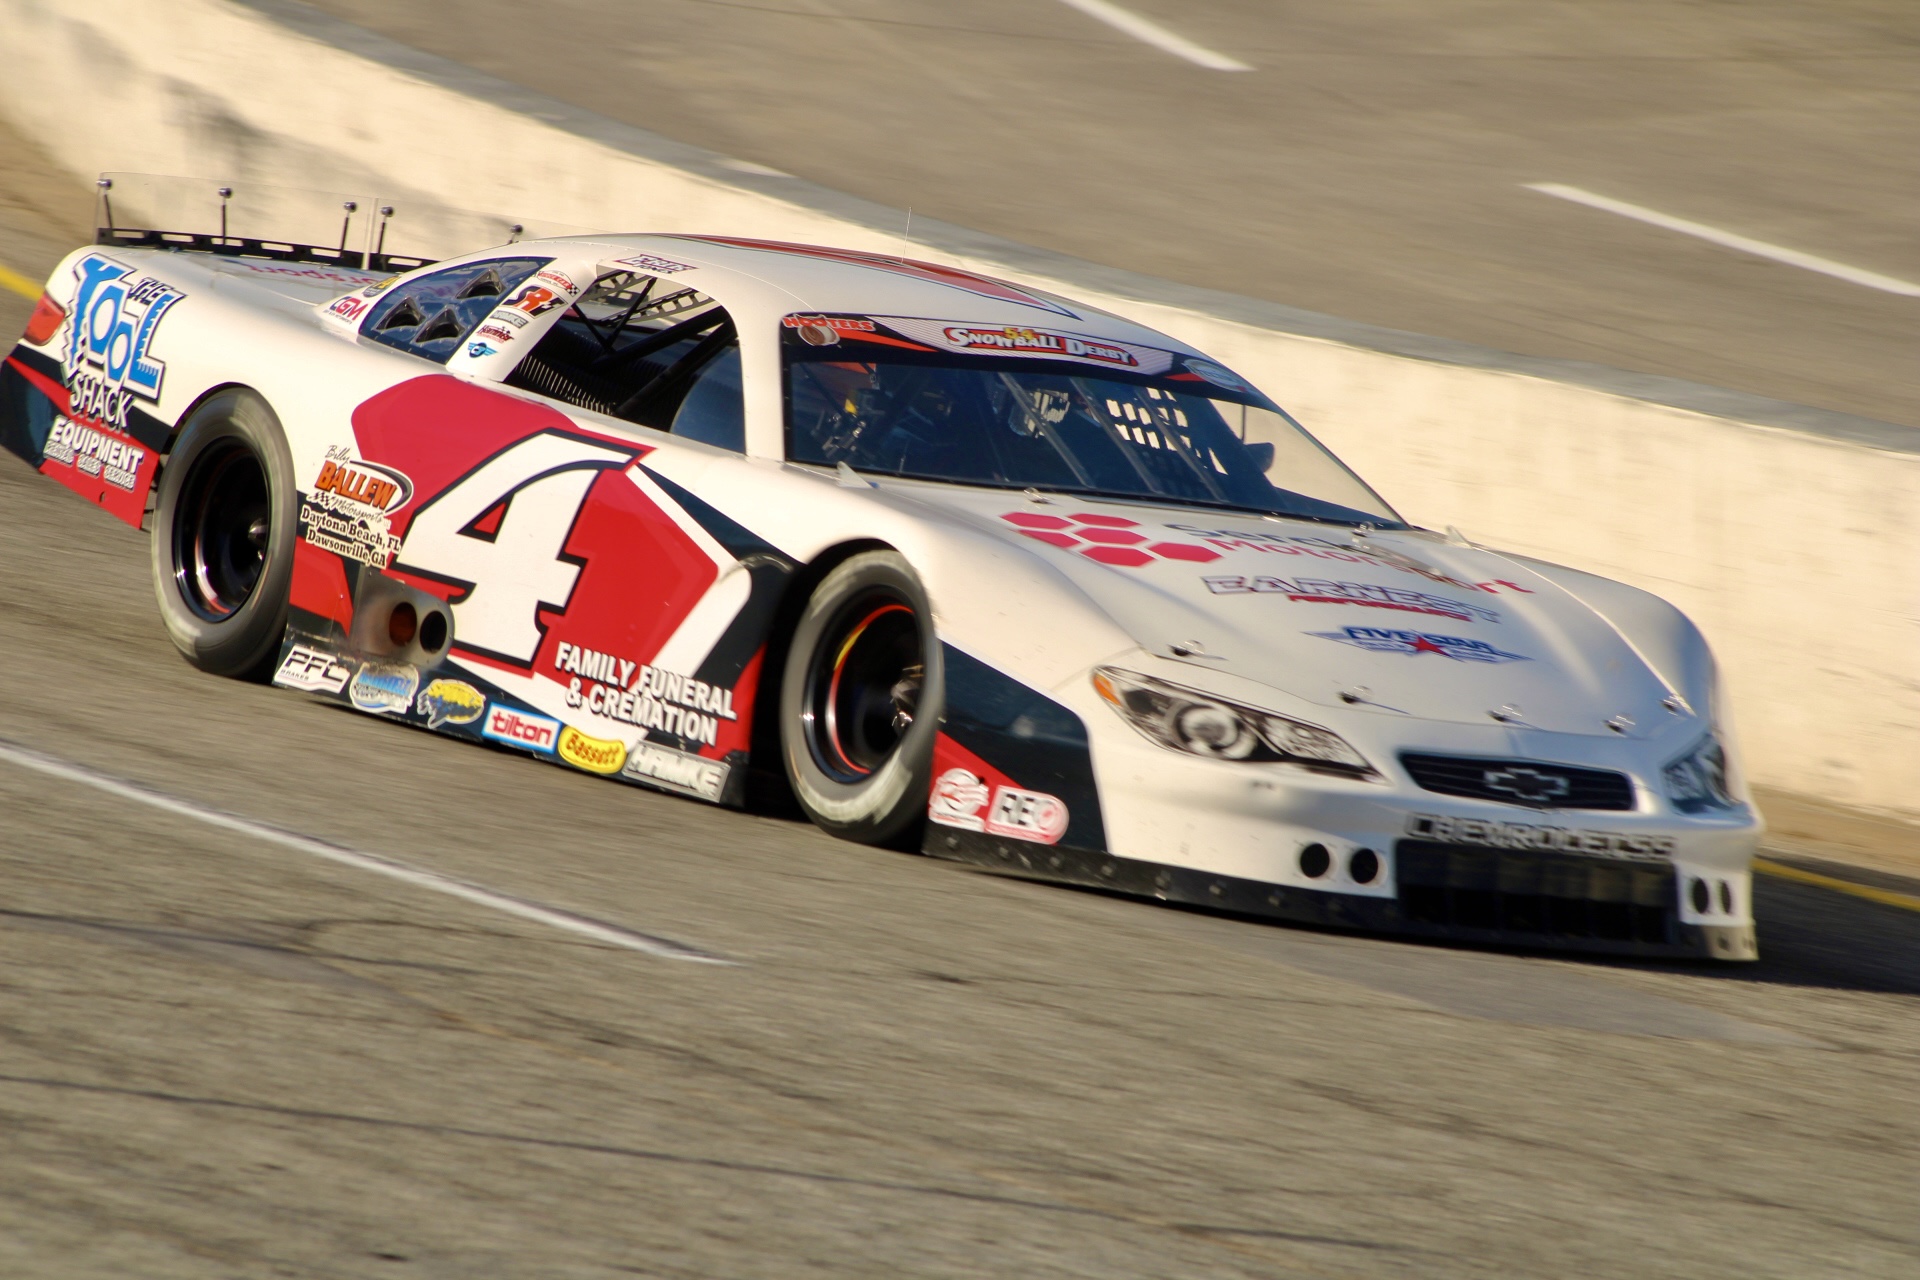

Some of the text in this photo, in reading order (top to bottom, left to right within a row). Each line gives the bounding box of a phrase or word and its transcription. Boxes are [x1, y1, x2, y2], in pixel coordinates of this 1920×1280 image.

[128, 277, 173, 305] THE
[65, 254, 186, 403] TOOL
[783, 316, 877, 332] HOOTERS
[1065, 338, 1131, 365] DERBY
[70, 371, 134, 429] SHACK
[47, 414, 145, 474] EQUIPMENT
[325, 444, 351, 471] Billy
[314, 459, 398, 511] BALLEW
[302, 507, 401, 552] Daytona Beach, FL
[391, 427, 645, 669] 4
[1204, 537, 1535, 595] Motorsport
[1345, 625, 1416, 641] FIVE
[285, 650, 343, 683] PFC
[555, 640, 738, 721] FAMILY FUNERAL
[492, 711, 553, 746] tilton
[565, 676, 718, 747] & CREMATION
